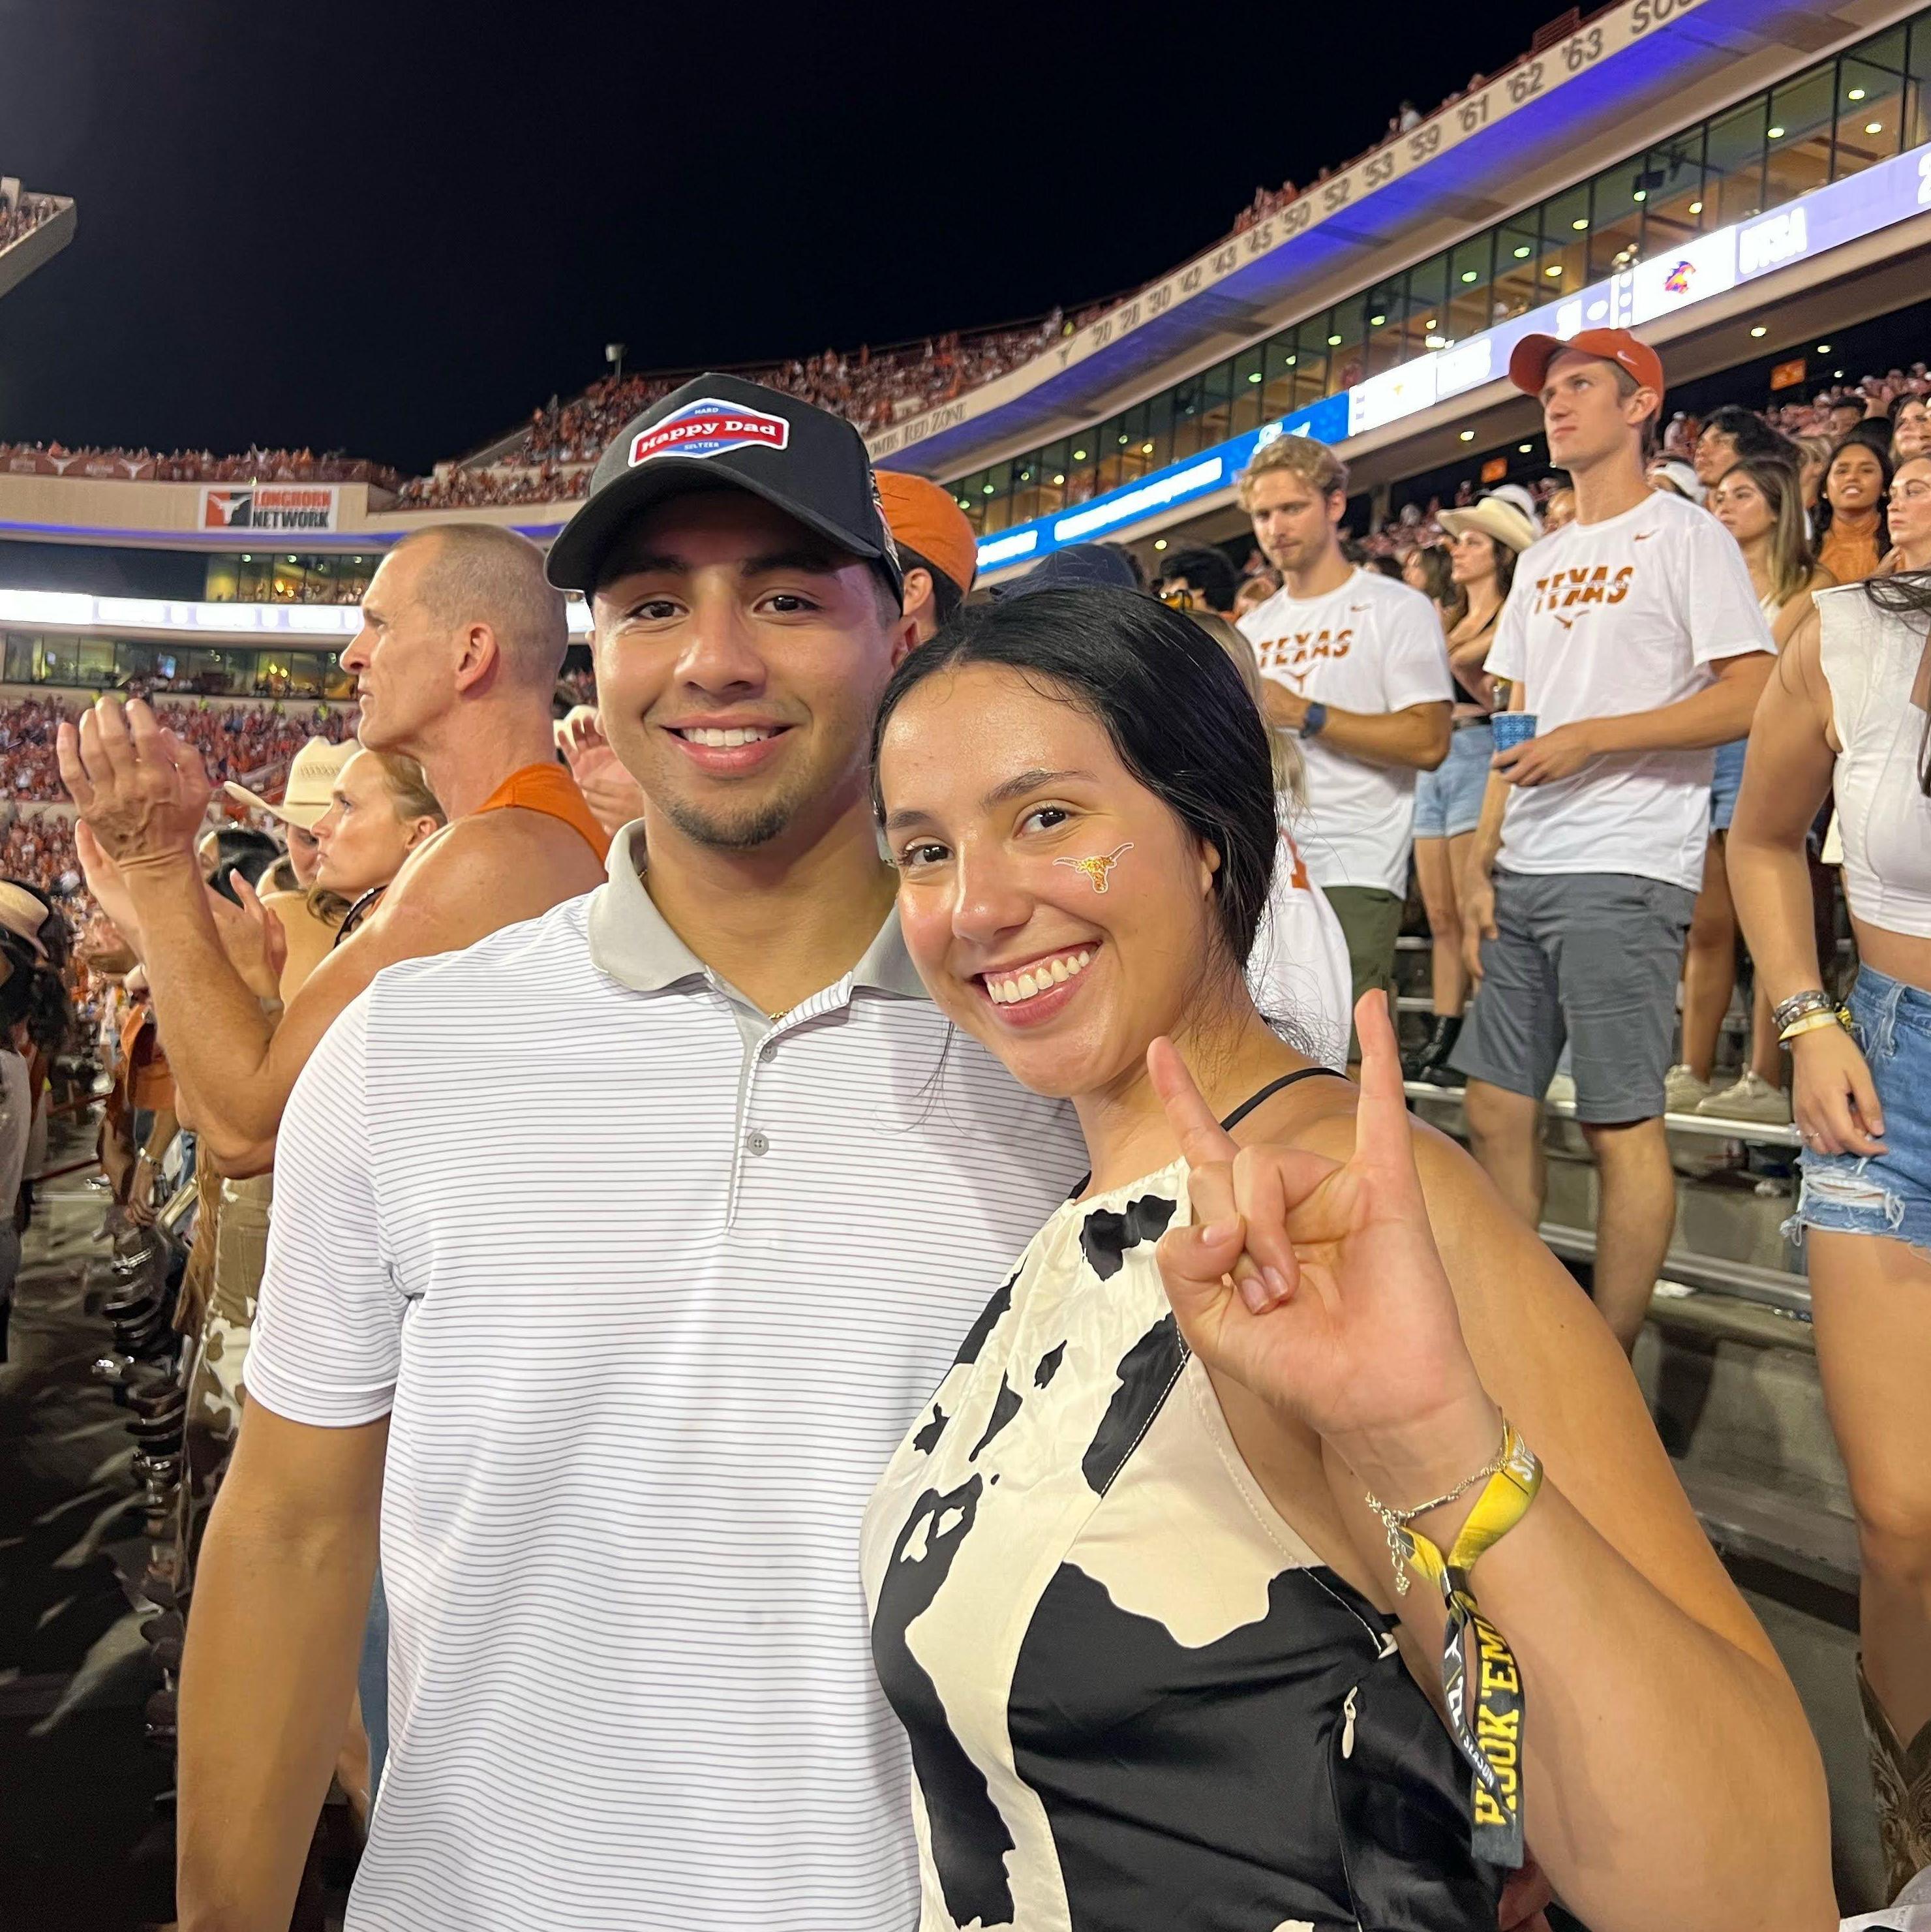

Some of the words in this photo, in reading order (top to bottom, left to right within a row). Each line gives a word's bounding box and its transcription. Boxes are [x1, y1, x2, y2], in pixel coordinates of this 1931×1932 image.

[1362, 151, 1395, 187] '53
[1456, 94, 1490, 130] '61
[1506, 62, 1544, 104] '62
[1562, 27, 1603, 70] '63
[932, 401, 967, 431] ZONE
[641, 422, 720, 453] Happy
[724, 420, 777, 437] Dad
[252, 510, 329, 528] NETWORK
[1534, 566, 1634, 615] TEXAS
[1260, 629, 1353, 667] TEXAS
